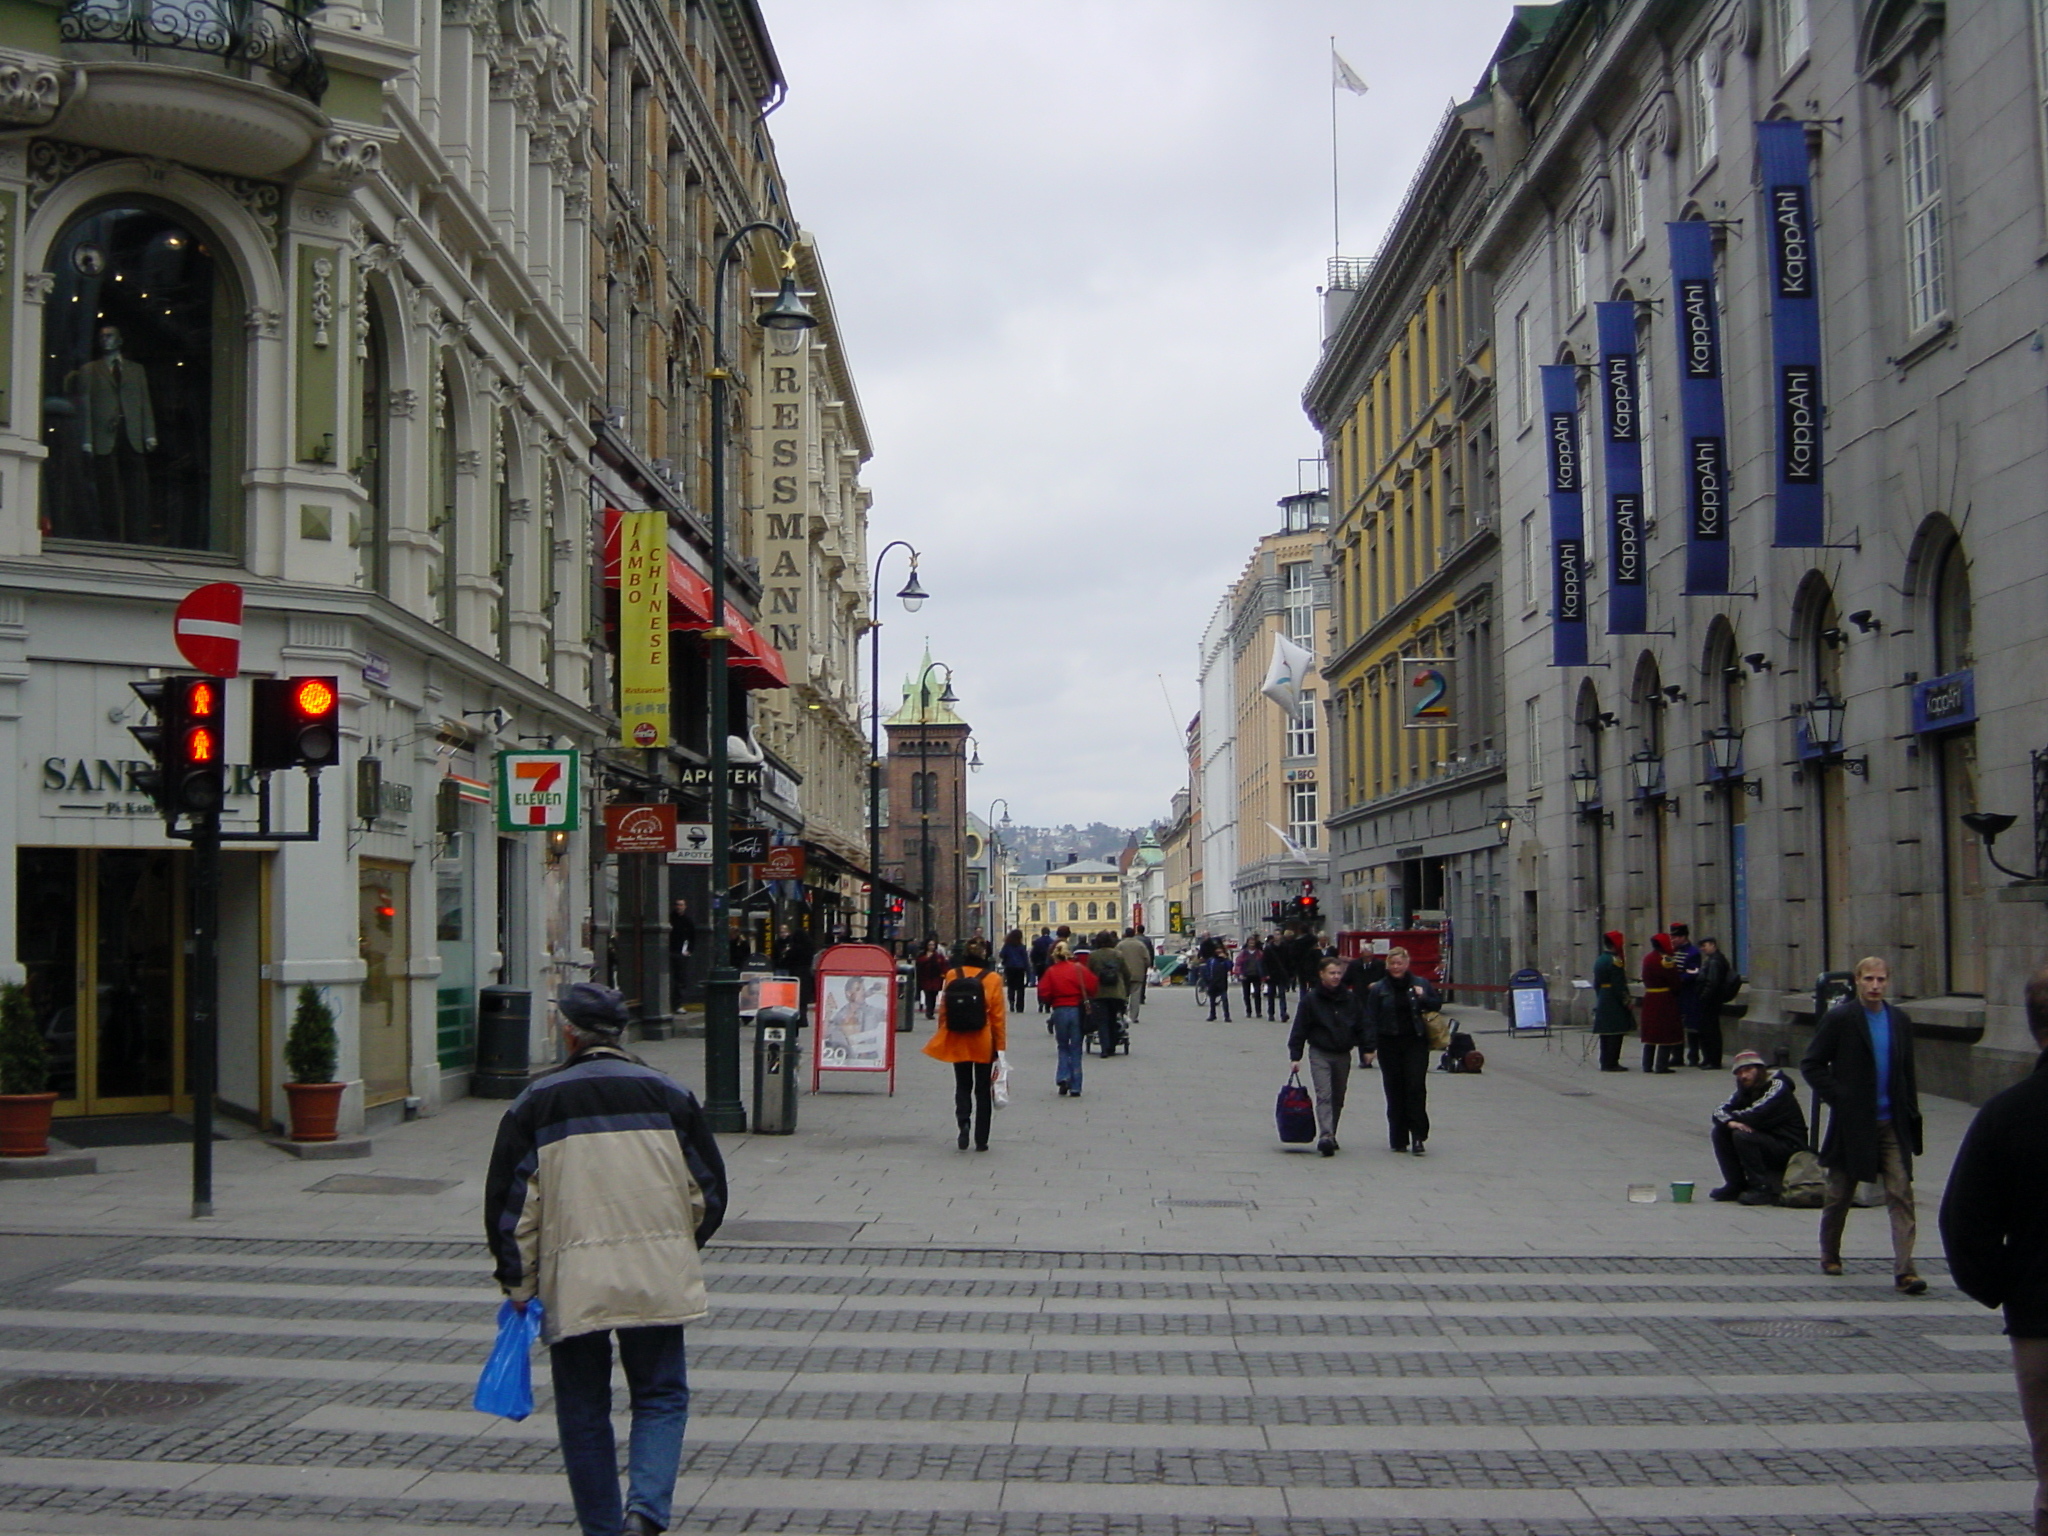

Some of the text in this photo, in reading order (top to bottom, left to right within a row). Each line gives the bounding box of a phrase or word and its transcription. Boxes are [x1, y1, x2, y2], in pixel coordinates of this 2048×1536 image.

[1777, 191, 1804, 292] KappAhl
[1686, 285, 1710, 374] KappAhl
[1613, 358, 1635, 439] KappAhl
[1788, 372, 1814, 477] KappAhl
[766, 336, 805, 651] RESSMANN
[1554, 416, 1575, 490] KappAhl
[1696, 442, 1720, 535] KappAhl
[628, 522, 643, 604] JAMBO
[1617, 499, 1639, 581] KappAhl
[648, 548, 662, 665] CHINESE
[1561, 543, 1580, 619] KappAhl
[624, 686, 666, 695] Restaurant
[1412, 669, 1449, 717] 2
[43, 756, 260, 796] SANDR
[515, 762, 561, 826] 7
[681, 769, 758, 784] APTEK
[823, 1046, 848, 1067] 29
